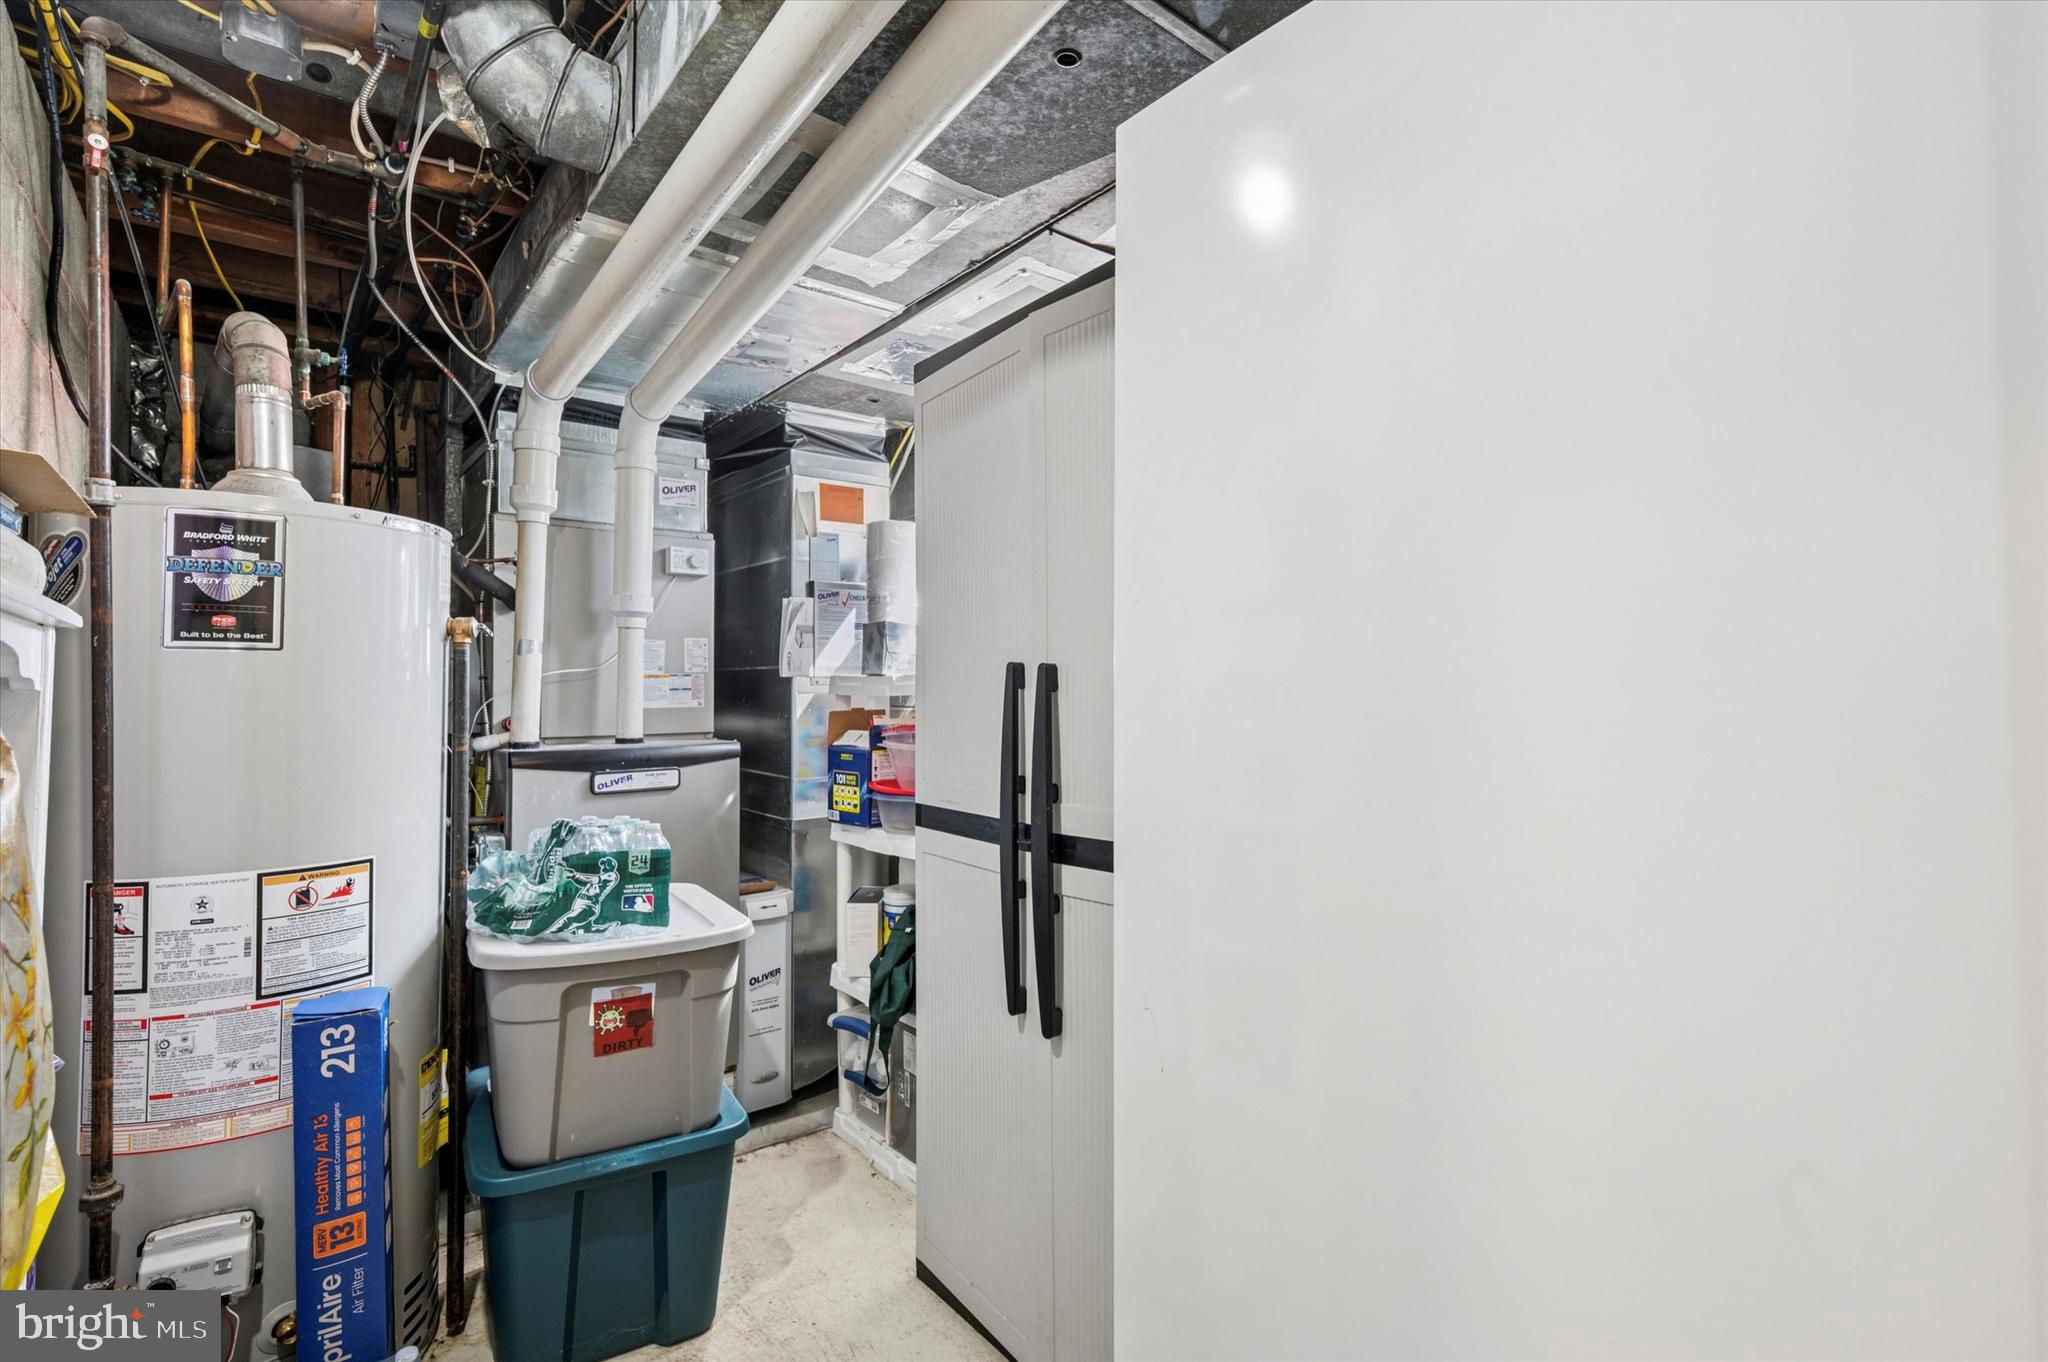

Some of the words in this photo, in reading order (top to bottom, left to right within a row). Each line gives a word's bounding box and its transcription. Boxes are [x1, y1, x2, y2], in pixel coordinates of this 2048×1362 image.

[662, 484, 697, 495] OLIVER
[183, 531, 235, 541] BRADFORD
[236, 534, 267, 543] WHITE
[167, 556, 283, 577] DEFENDER
[184, 576, 221, 585] SAFETY
[223, 577, 264, 587] SYSTEM
[817, 591, 840, 600] OLIVER
[597, 774, 633, 790] OLIVER
[835, 774, 846, 784] 101
[631, 855, 648, 866] 24
[307, 870, 340, 880] WARNING
[749, 967, 781, 986] OLIVER
[320, 1023, 356, 1078] 213
[603, 1038, 643, 1054] DIRTY
[313, 1114, 328, 1130] 13
[333, 1102, 342, 1132] Allergens
[313, 1133, 329, 1152] Air
[333, 1133, 341, 1164] Common
[314, 1157, 333, 1217] Healthy
[317, 1229, 327, 1253] MERV
[330, 1222, 355, 1250] 13
[351, 1267, 364, 1297] Filter
[352, 1299, 365, 1314] Air
[316, 1274, 352, 1362] prilAire
